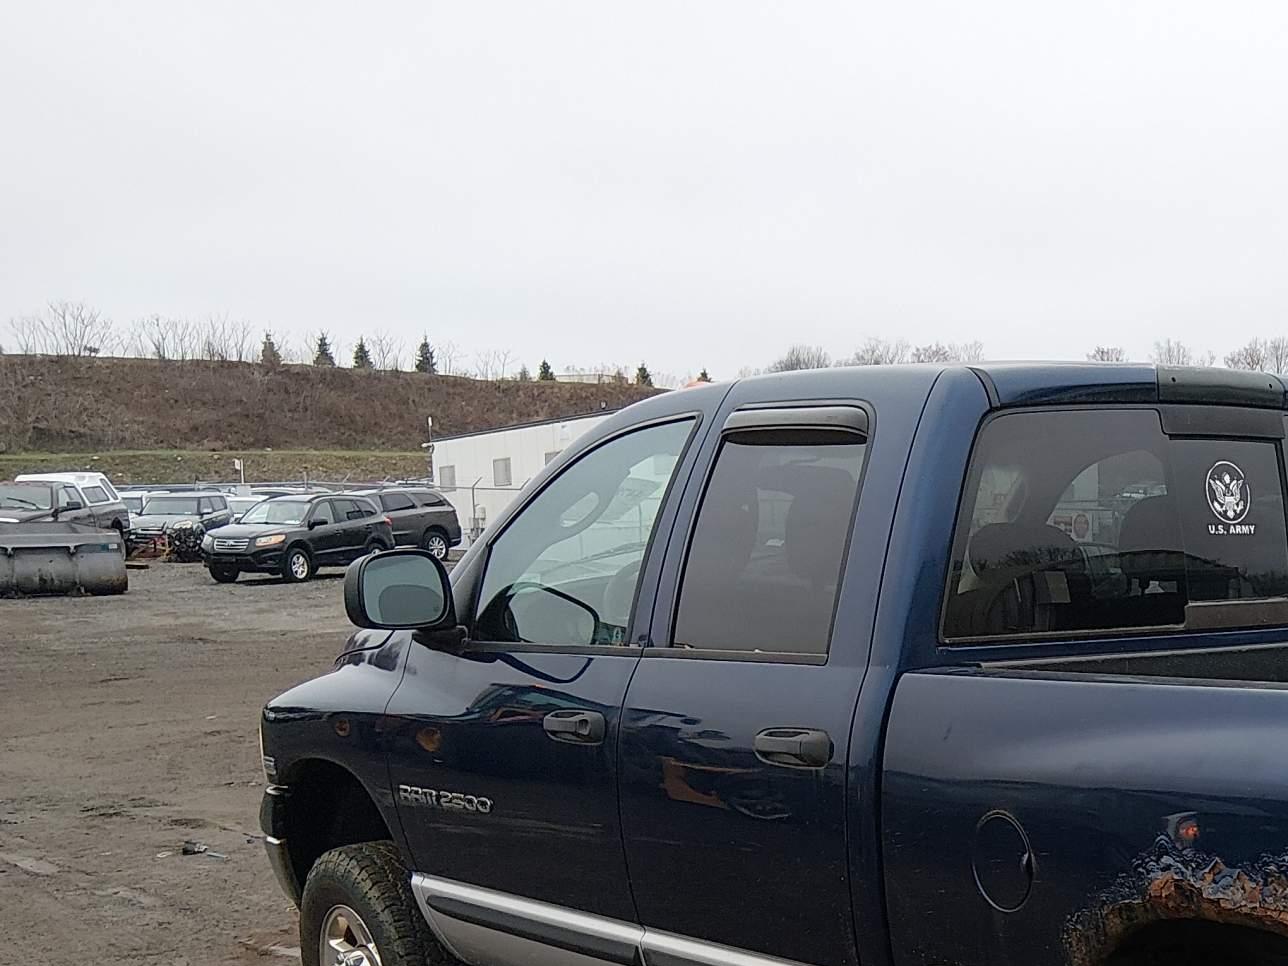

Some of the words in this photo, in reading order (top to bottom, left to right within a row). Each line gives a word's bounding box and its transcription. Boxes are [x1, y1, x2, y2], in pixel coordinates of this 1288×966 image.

[1208, 525, 1227, 535] U.S.
[1229, 525, 1255, 535] ARMY
[439, 791, 491, 813] 2500
